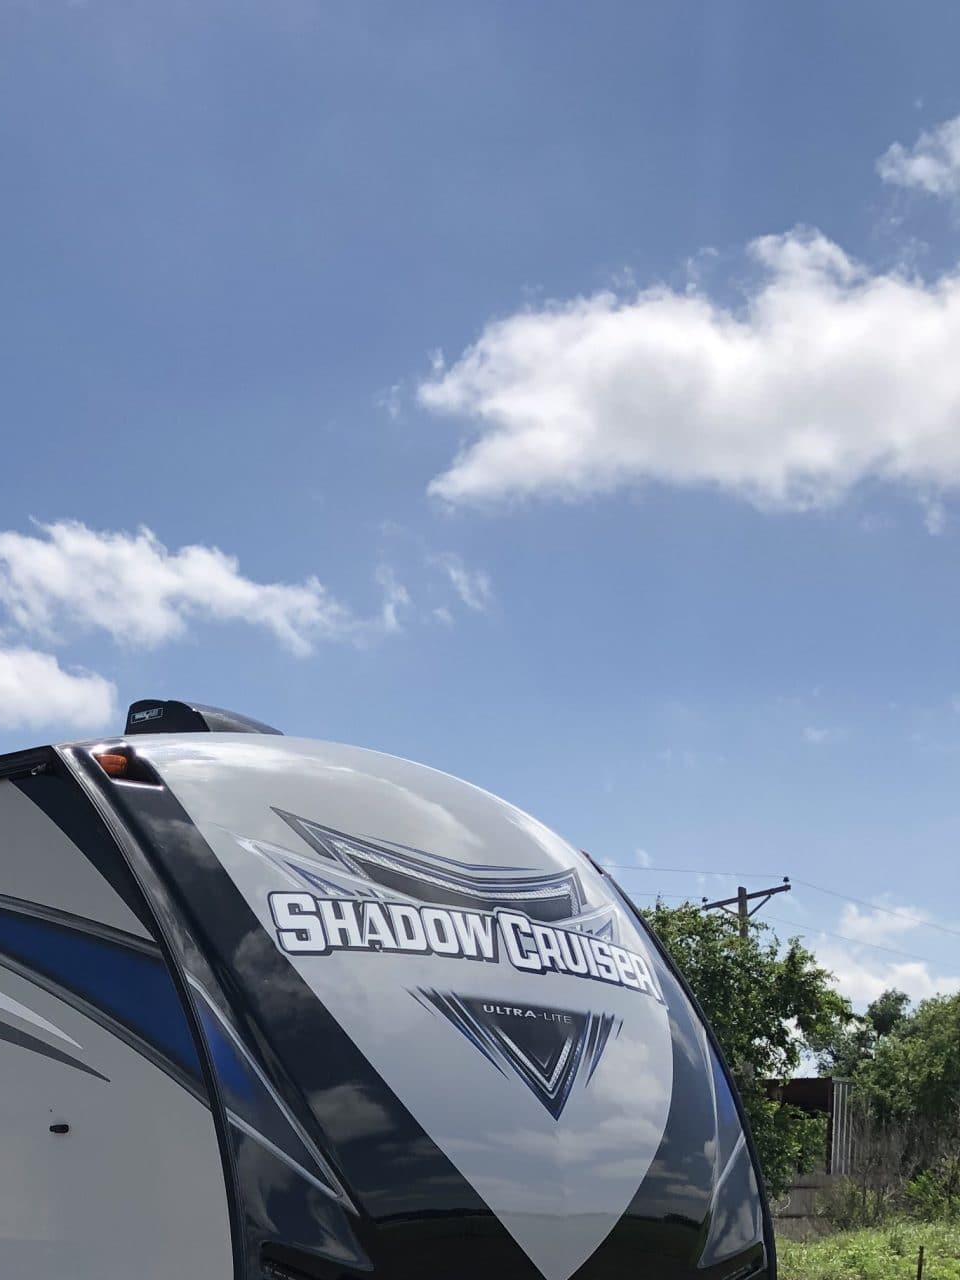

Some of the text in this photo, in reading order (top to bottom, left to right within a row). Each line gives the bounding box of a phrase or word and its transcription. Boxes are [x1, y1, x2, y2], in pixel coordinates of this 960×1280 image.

[269, 891, 666, 1004] SHADOW CRUISER
[482, 1003, 573, 1025] ULTRA-LITE
